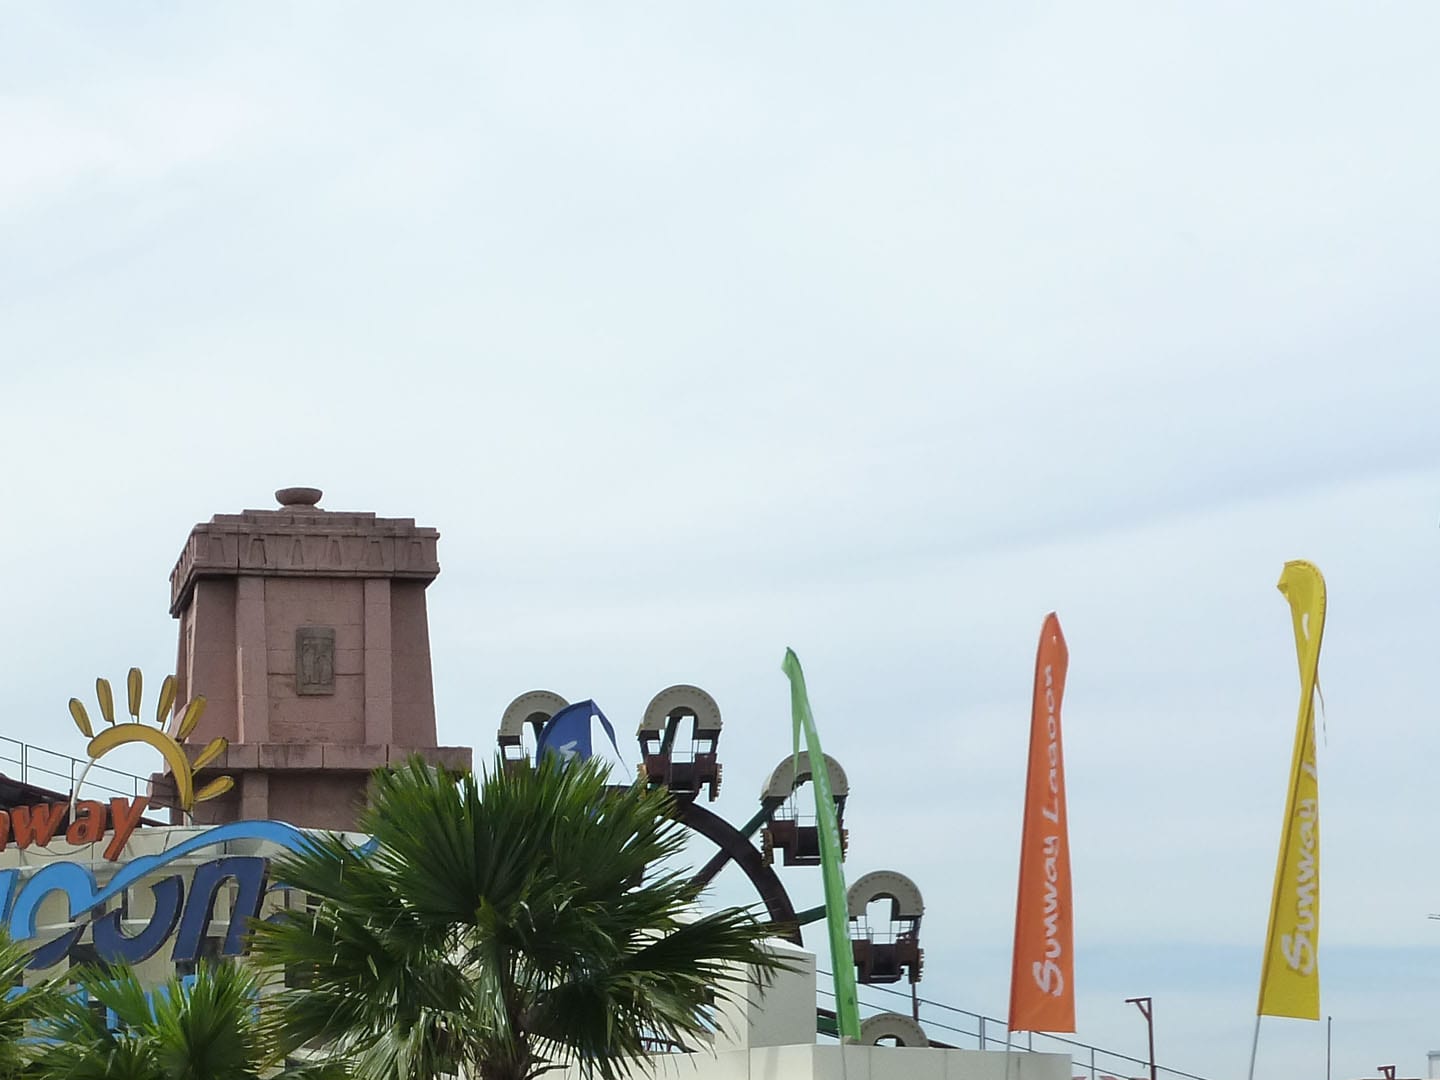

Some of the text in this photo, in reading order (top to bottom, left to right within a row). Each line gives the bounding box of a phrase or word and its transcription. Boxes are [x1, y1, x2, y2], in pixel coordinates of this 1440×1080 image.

[1032, 665, 1064, 997] Sunway Lagoon
[1281, 796, 1317, 975] Sunway
